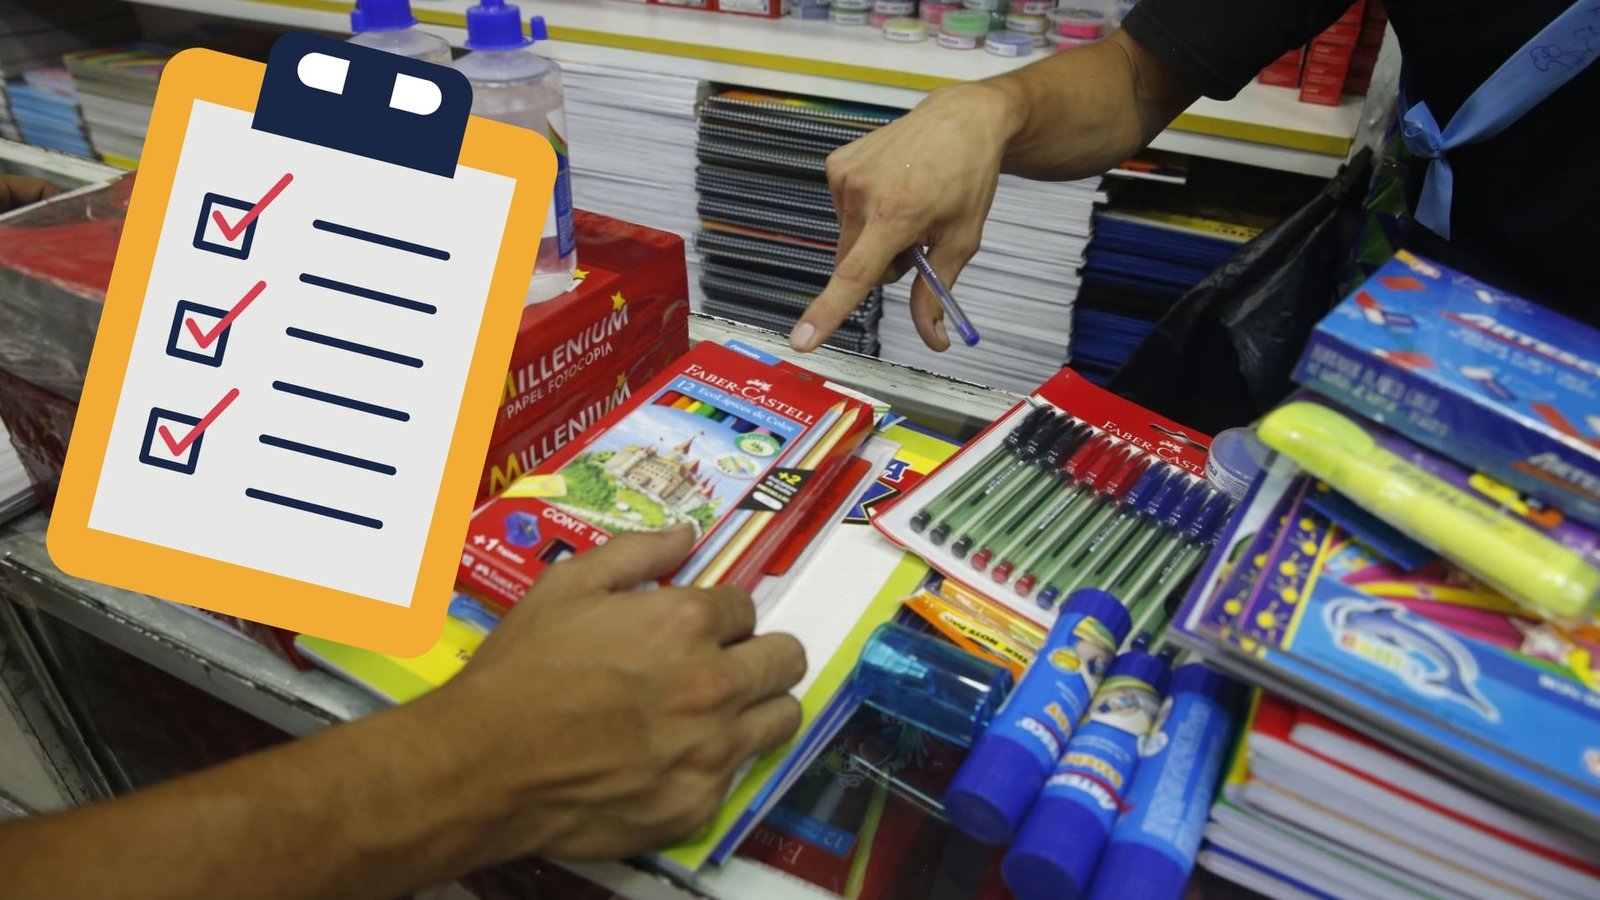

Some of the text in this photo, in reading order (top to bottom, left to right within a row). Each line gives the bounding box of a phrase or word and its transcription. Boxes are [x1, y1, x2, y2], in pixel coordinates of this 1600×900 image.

[500, 304, 628, 408] MILLENIUM
[507, 342, 613, 419] PAPEL FOTOCOPIA
[676, 379, 696, 392] 12
[753, 409, 766, 419] de
[766, 415, 794, 432] Color
[684, 364, 813, 425] FABER-CASTELL
[489, 381, 631, 496] MILLENIUM
[778, 472, 802, 485] +2
[542, 507, 609, 546] CONT. 16
[968, 629, 998, 647] NOTE
